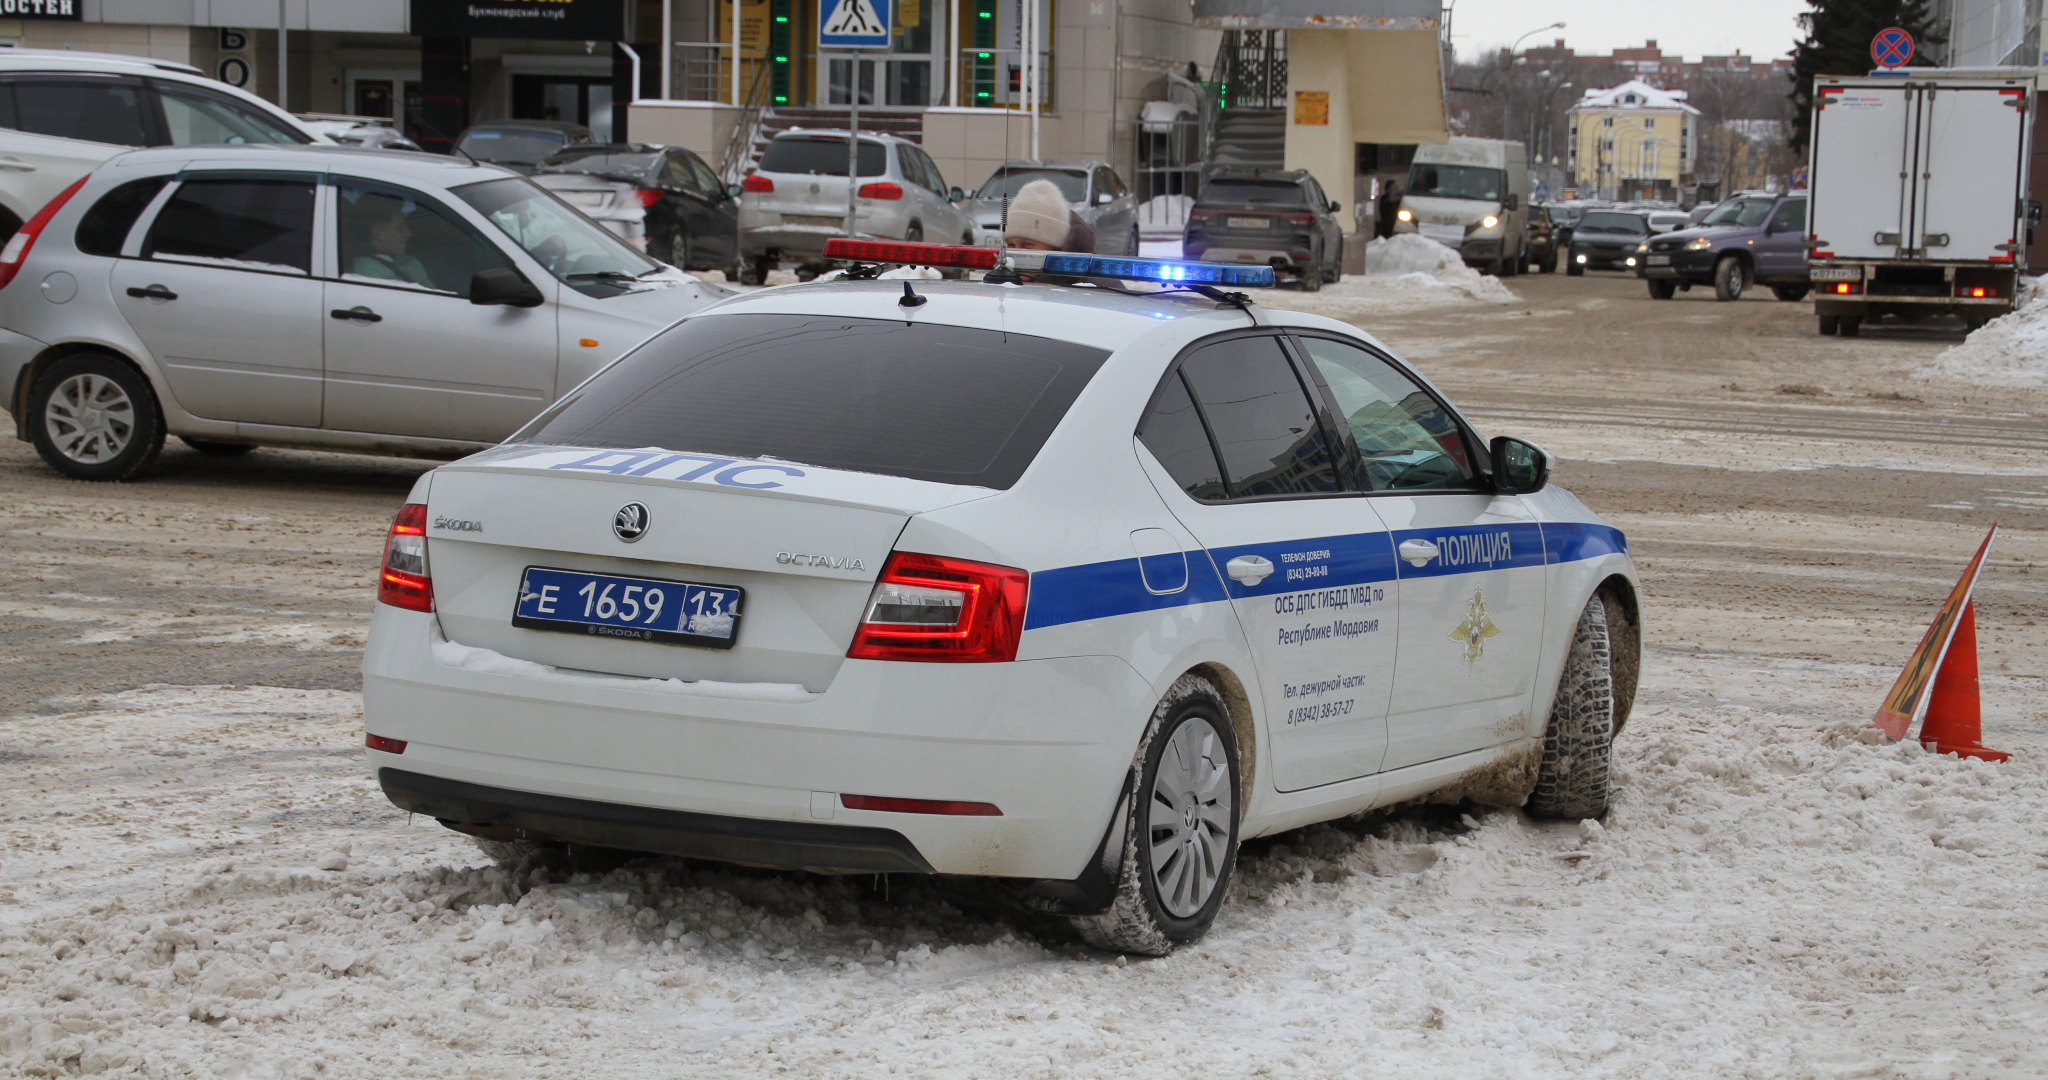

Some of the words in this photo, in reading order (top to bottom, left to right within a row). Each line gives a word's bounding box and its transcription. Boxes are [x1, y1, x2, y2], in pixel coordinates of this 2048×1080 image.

[0, 0, 74, 16] ОСТЕН
[549, 450, 806, 490] ДПС
[776, 551, 866, 572] OCTAVIA
[1280, 553, 1306, 564] ТЕЛЕФОН
[1306, 549, 1331, 563] ДОВЕРИЯ
[1436, 531, 1512, 568] ПОЛИЦИЯ
[1286, 567, 1305, 583] (8342)
[537, 584, 561, 614] Е
[578, 580, 665, 625] 1659
[690, 590, 725, 618] 13
[1275, 595, 1294, 614] ОСБ
[1296, 592, 1316, 616] ДПС
[1318, 589, 1349, 611] ГИБДД
[1350, 586, 1371, 607] МВД
[1373, 588, 1384, 602] по
[598, 626, 641, 638] ŠKODA
[1278, 623, 1332, 647] Республике
[1333, 619, 1379, 640] Мордовия
[1283, 683, 1298, 699] Тел.
[1299, 674, 1342, 699] дежурной
[1342, 675, 1366, 689] части:
[1287, 709, 1294, 725] 8
[1294, 703, 1320, 727] (8342)
[1320, 699, 1355, 719] 38-57-27
